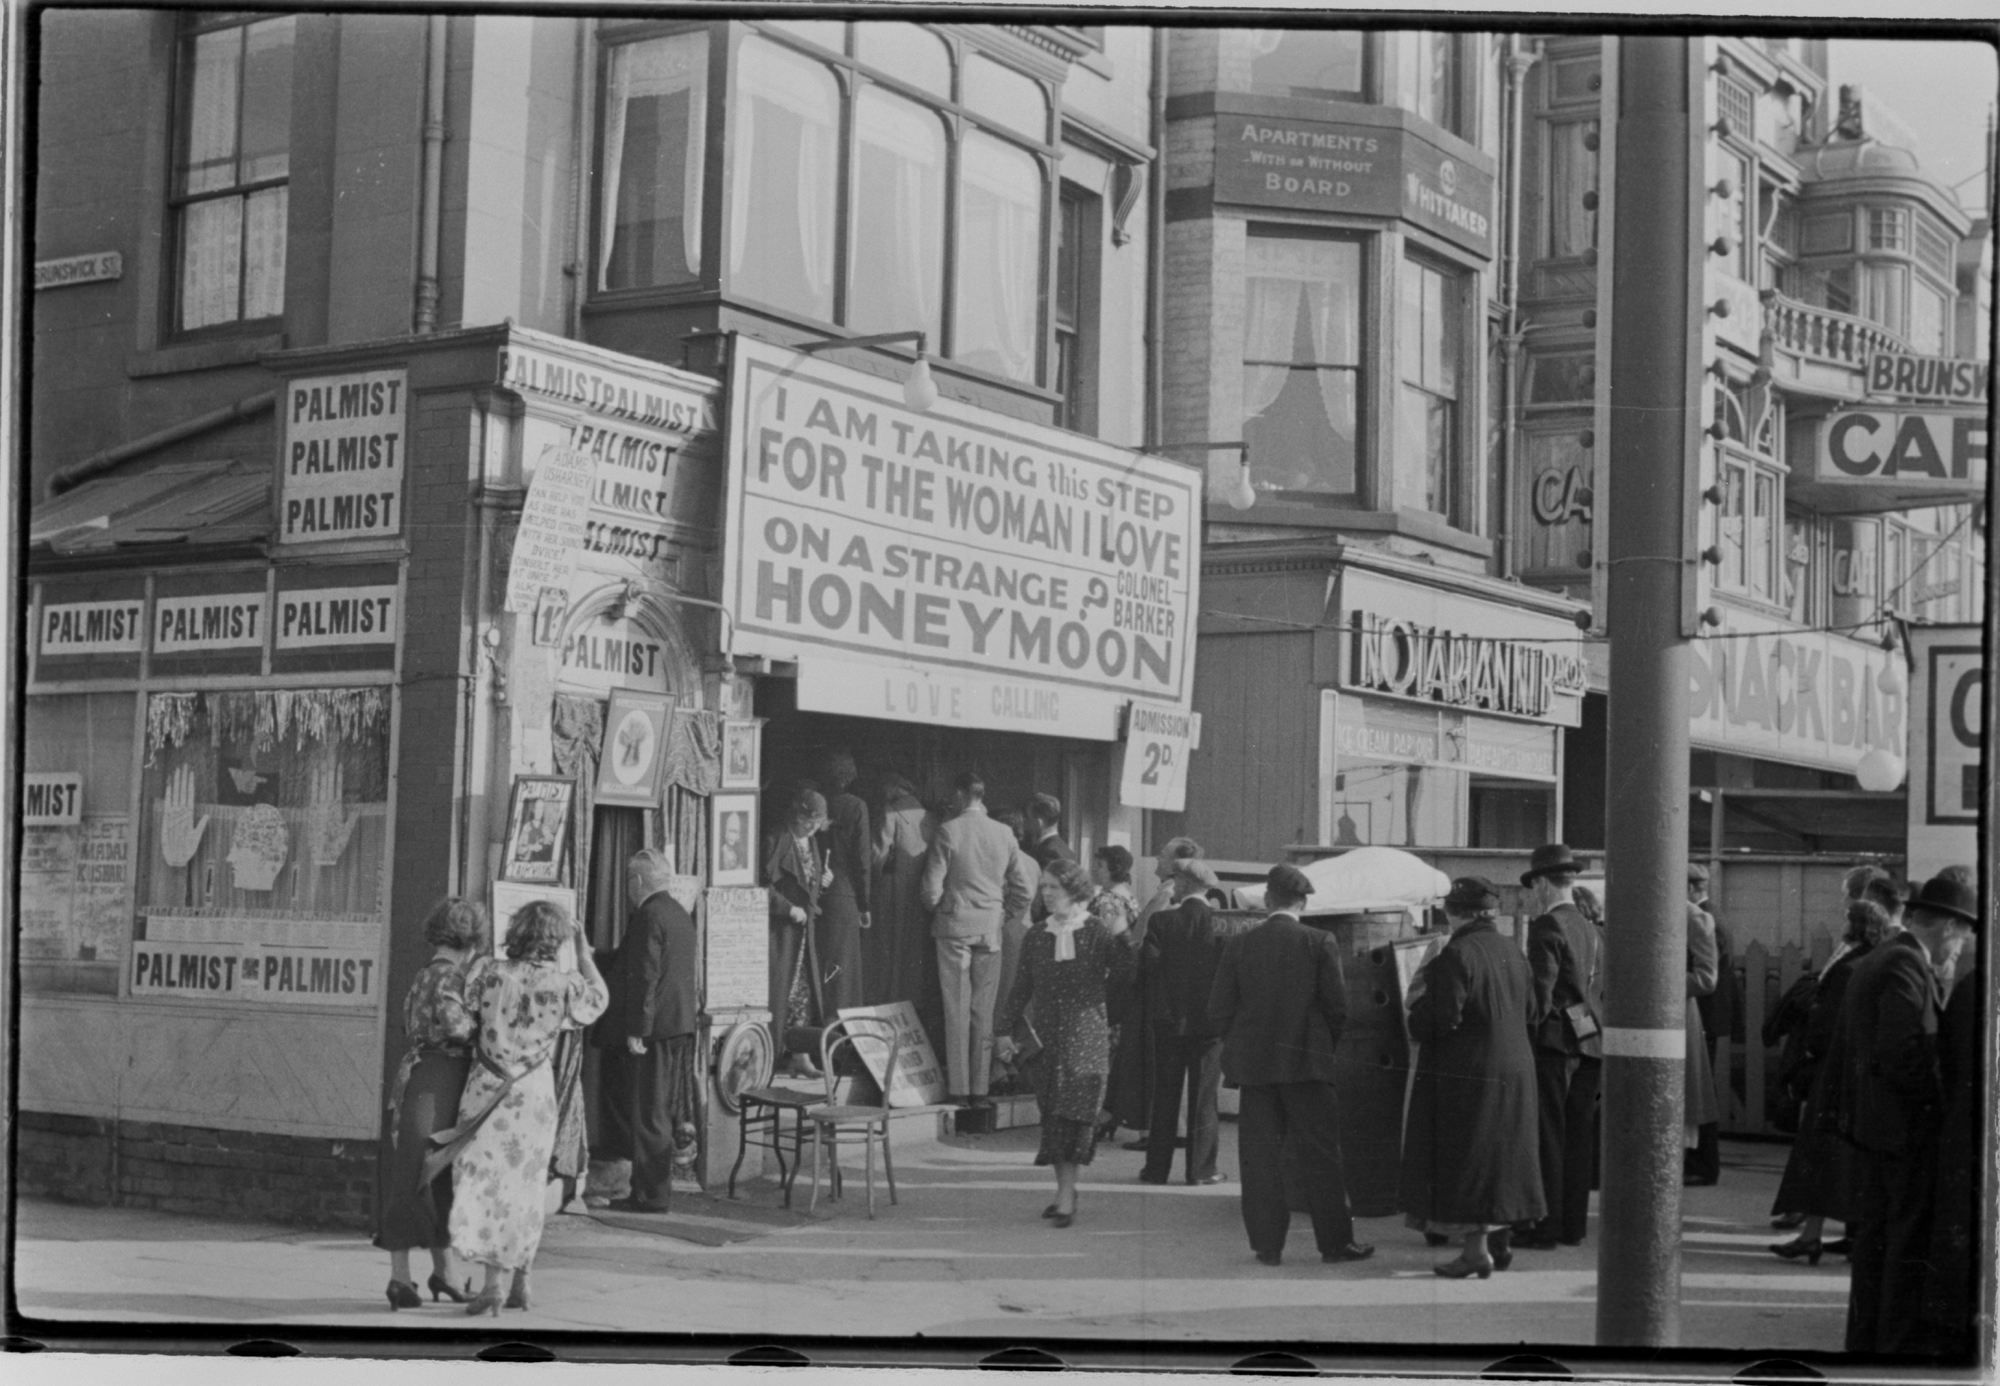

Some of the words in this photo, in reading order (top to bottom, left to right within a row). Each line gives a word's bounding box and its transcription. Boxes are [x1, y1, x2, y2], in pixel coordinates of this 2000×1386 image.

[1241, 124, 1379, 152] APARTMENTS
[1265, 173, 1350, 197] BOARD
[1407, 172, 1488, 238] WHITTAKER
[293, 379, 400, 424] PALMIST
[291, 433, 399, 475] PALMIST
[578, 425, 678, 477] PALMIST
[775, 387, 787, 421] I
[805, 398, 877, 447] AM
[891, 420, 1037, 488] TAKING
[1048, 462, 1089, 500] this
[1096, 476, 1175, 520] STEP
[287, 492, 394, 534] PALMIST
[759, 427, 847, 502] FOR
[861, 454, 934, 523] THE
[946, 476, 1073, 554] WOMAN
[1082, 510, 1091, 557] I
[1100, 514, 1180, 580] LOVE
[763, 517, 830, 563] ON
[838, 535, 874, 573] A
[882, 544, 1068, 611] STRANGE
[1116, 569, 1172, 605] COLONEL
[47, 608, 139, 643] PALMIST
[160, 604, 259, 642] PALMIST
[283, 598, 391, 637] PALMIST
[754, 559, 1172, 686] HONEYMOON
[1113, 602, 1175, 639] BARKER
[563, 634, 660, 677] PALMIST
[884, 678, 961, 719] LOVE
[991, 686, 1060, 722] CALLING
[1133, 709, 1190, 739] ADMISSION
[24, 784, 77, 817] MIST
[136, 952, 237, 991] PALMIST
[263, 956, 373, 995] PALMIST
